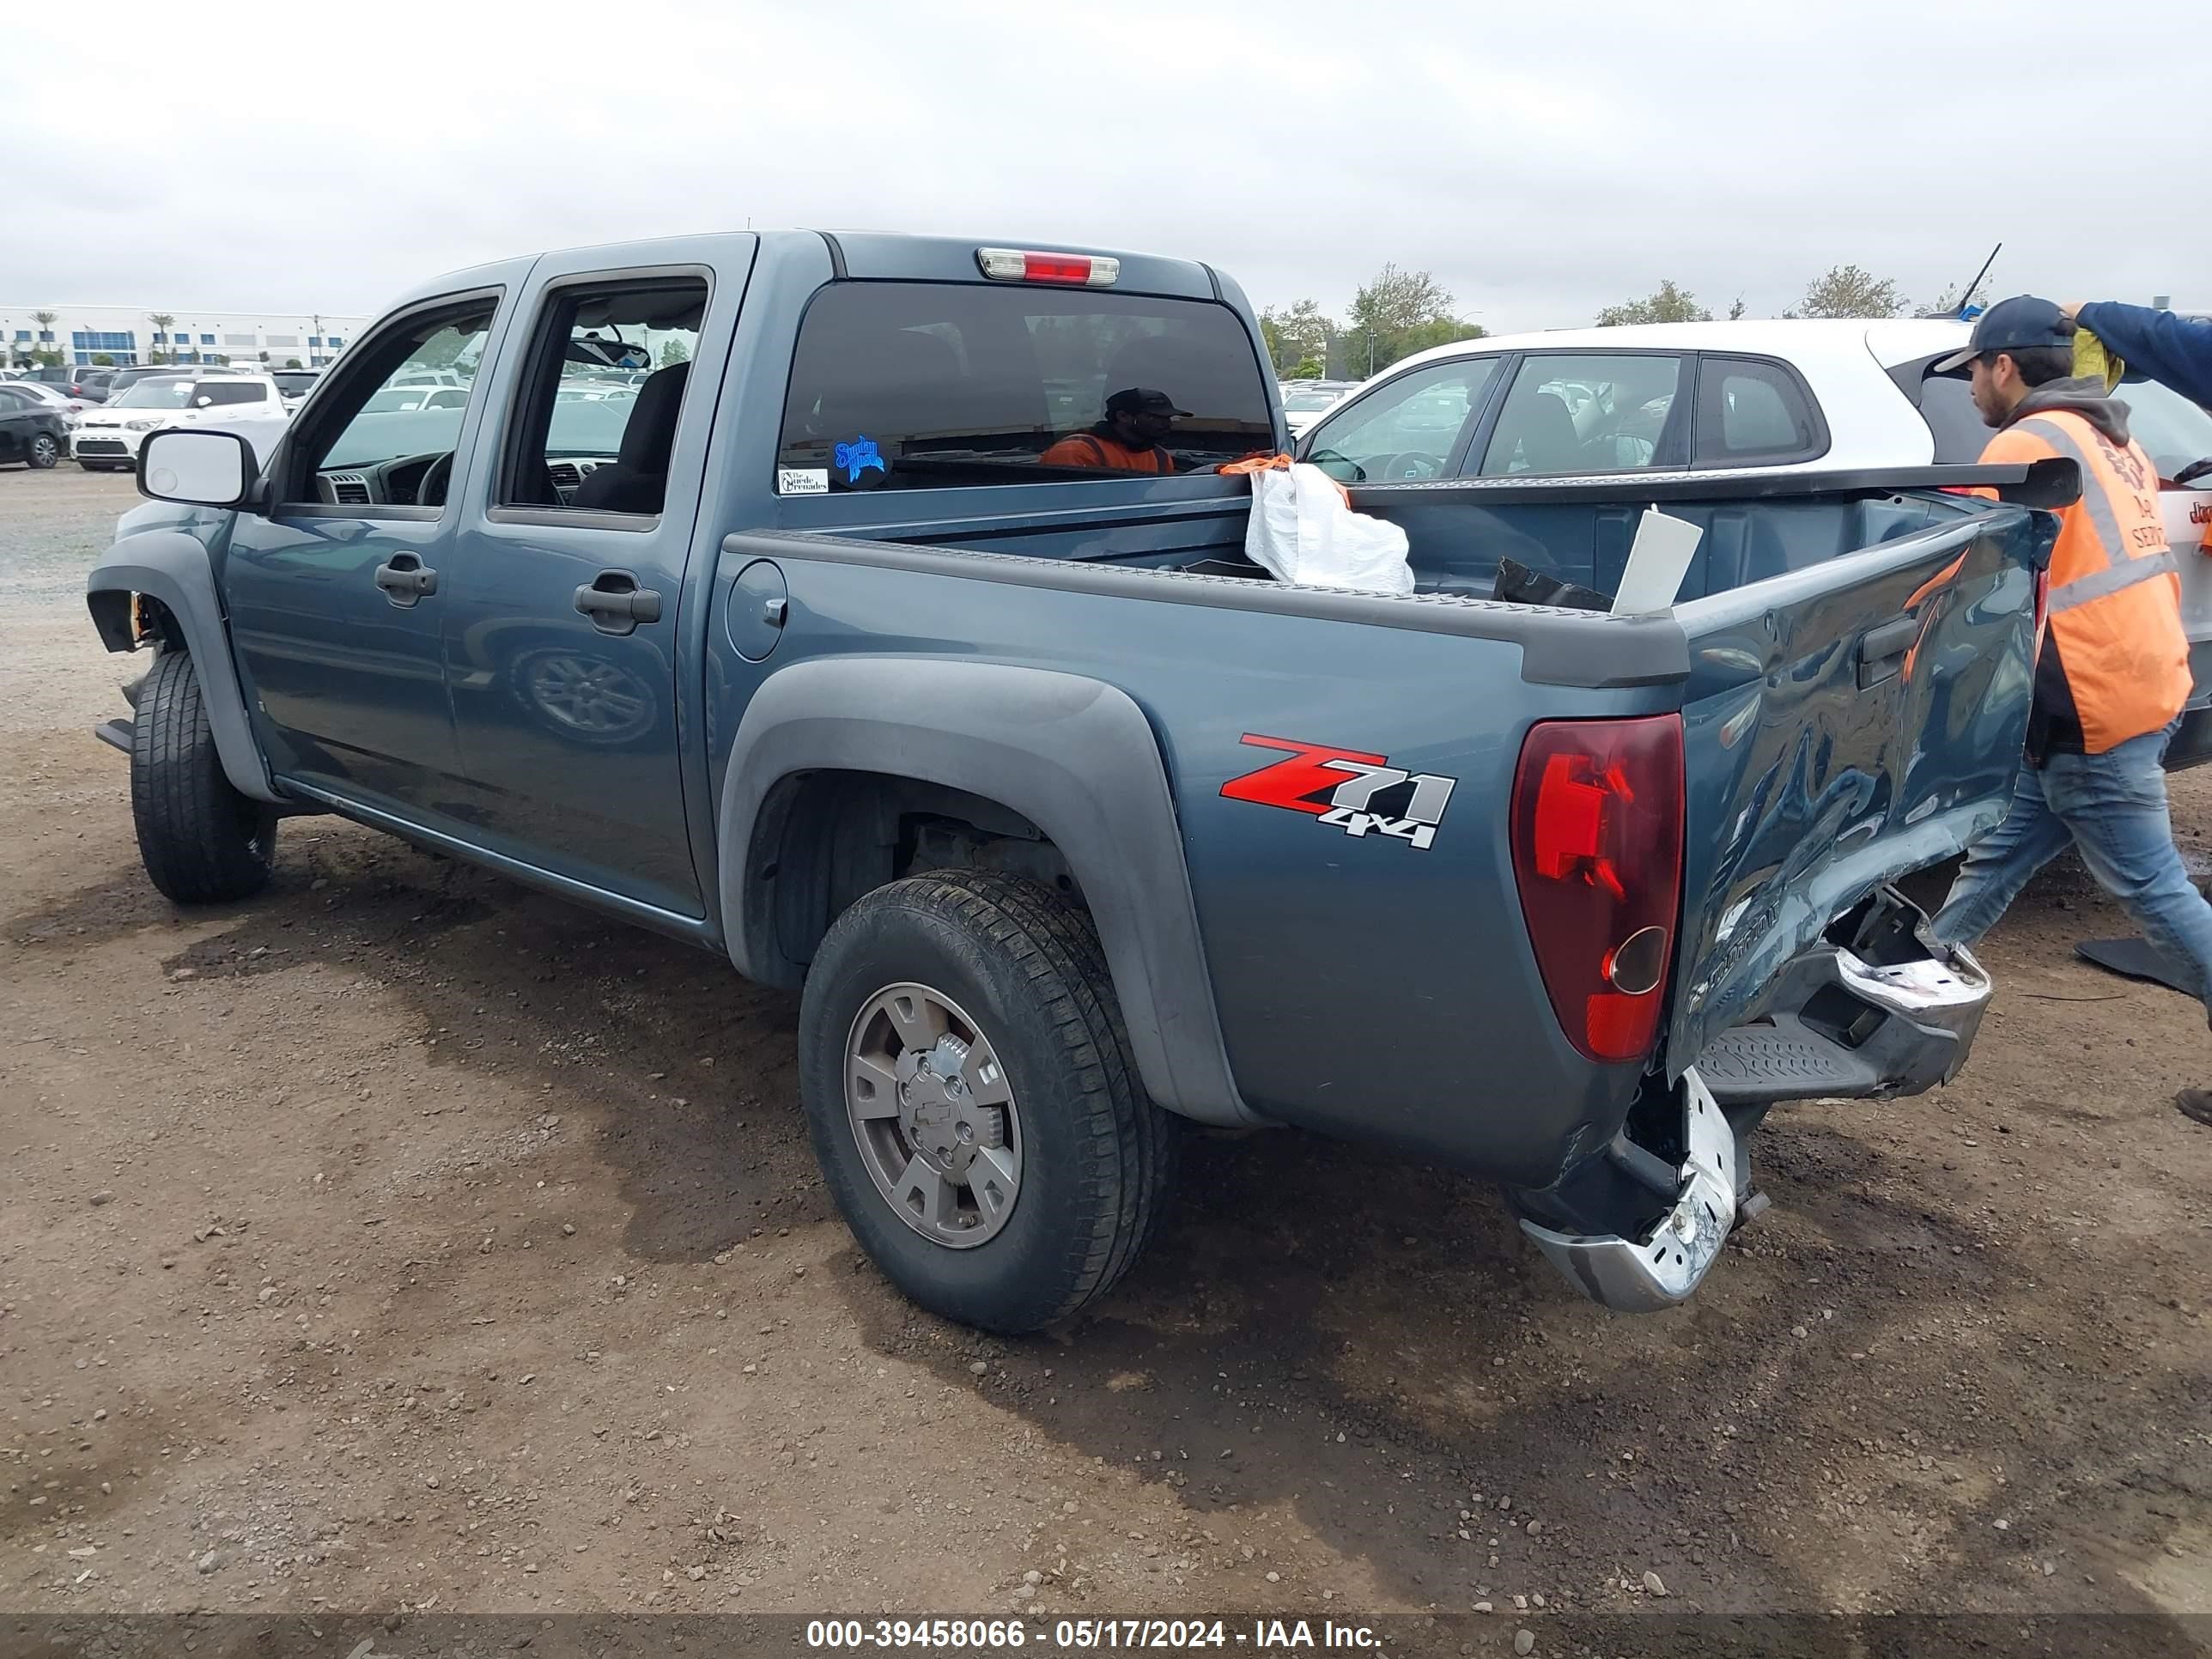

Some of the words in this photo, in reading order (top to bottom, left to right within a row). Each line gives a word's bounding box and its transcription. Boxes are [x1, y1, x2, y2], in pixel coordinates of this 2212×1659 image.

[836, 435, 878, 468] Sunday
[1218, 732, 1459, 827] Z71
[1316, 806, 1441, 851] 4x4
